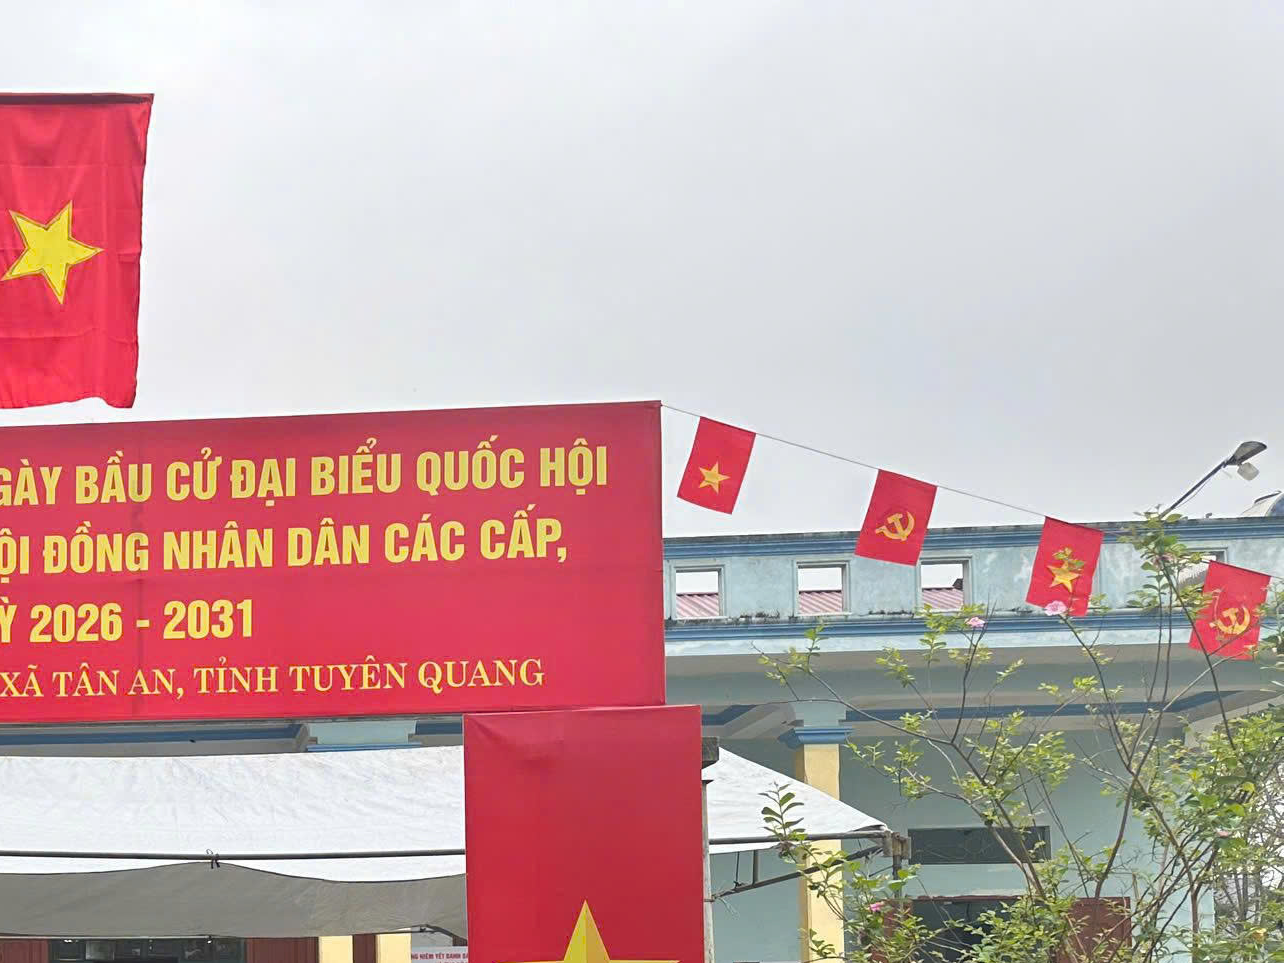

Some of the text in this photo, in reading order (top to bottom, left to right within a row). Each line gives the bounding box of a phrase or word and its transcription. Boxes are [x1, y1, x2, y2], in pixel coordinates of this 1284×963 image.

[75, 450, 152, 505] BẦU
[166, 447, 223, 501] CỬ
[229, 457, 296, 507] ĐẠI
[310, 437, 402, 496] BIỂU
[416, 434, 525, 497] QUỐC
[539, 437, 607, 496] HỘI
[43, 520, 149, 574] ĐỒNG
[163, 520, 273, 571] NHÂN
[287, 517, 370, 567] DÂN
[384, 513, 465, 564] CÁC
[480, 503, 567, 564] CẤP,
[29, 602, 123, 643] 2026
[163, 599, 253, 640] 2031
[52, 663, 119, 697] TÂN
[128, 668, 184, 699] AN,
[192, 655, 279, 695] TỈNH
[289, 655, 405, 692] TUYÊN
[418, 658, 544, 694] QUANG
